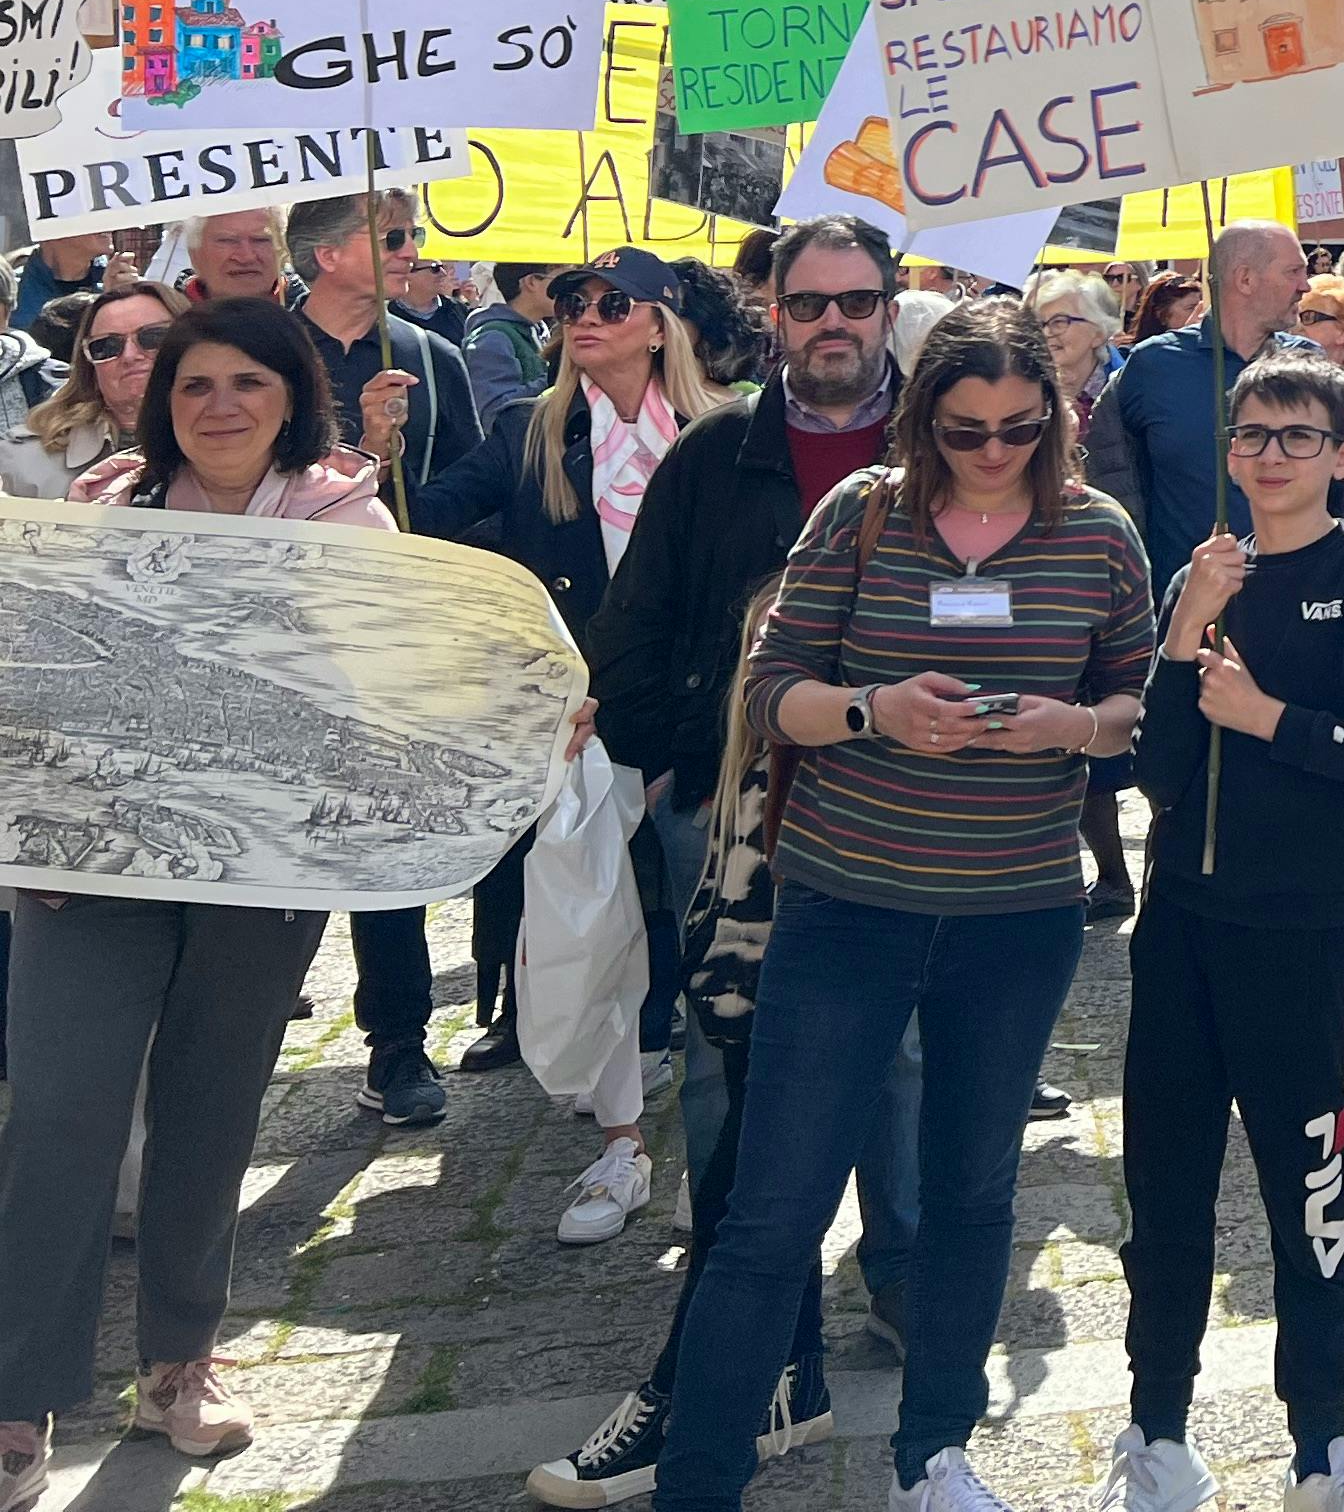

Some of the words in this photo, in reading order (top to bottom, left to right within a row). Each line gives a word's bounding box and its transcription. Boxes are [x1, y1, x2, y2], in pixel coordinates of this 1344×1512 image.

[273, 28, 456, 90] GHE
[885, 2, 1144, 76] RESTAURIAMO
[897, 75, 949, 119] LE
[29, 126, 452, 221] PRESENTE
[904, 80, 1146, 206] CASE
[1301, 599, 1344, 621] VANS
